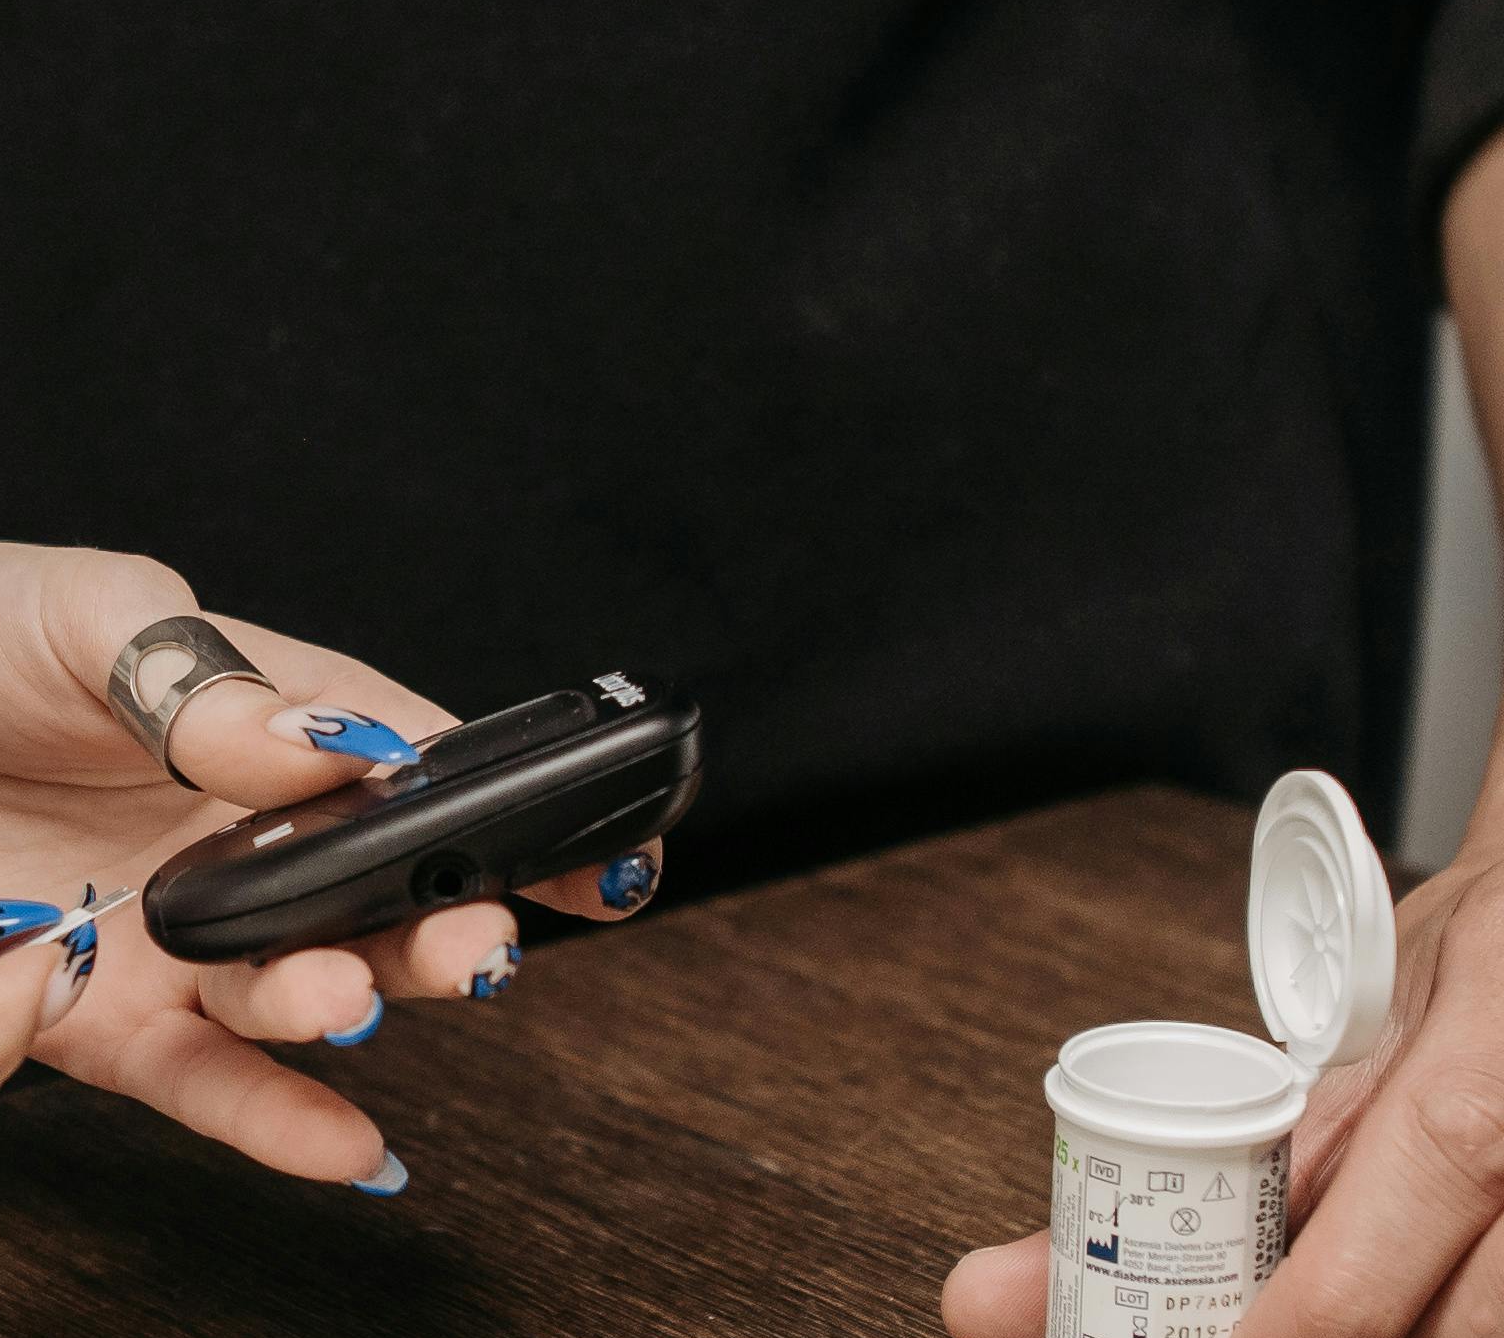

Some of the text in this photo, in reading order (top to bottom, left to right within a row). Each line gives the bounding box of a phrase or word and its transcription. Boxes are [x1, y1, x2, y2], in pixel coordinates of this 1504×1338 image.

[1094, 1163, 1115, 1179] IVD
[1085, 1261, 1239, 1286] www.diabetes.ascensia.com
[1119, 1291, 1144, 1304] LOT
